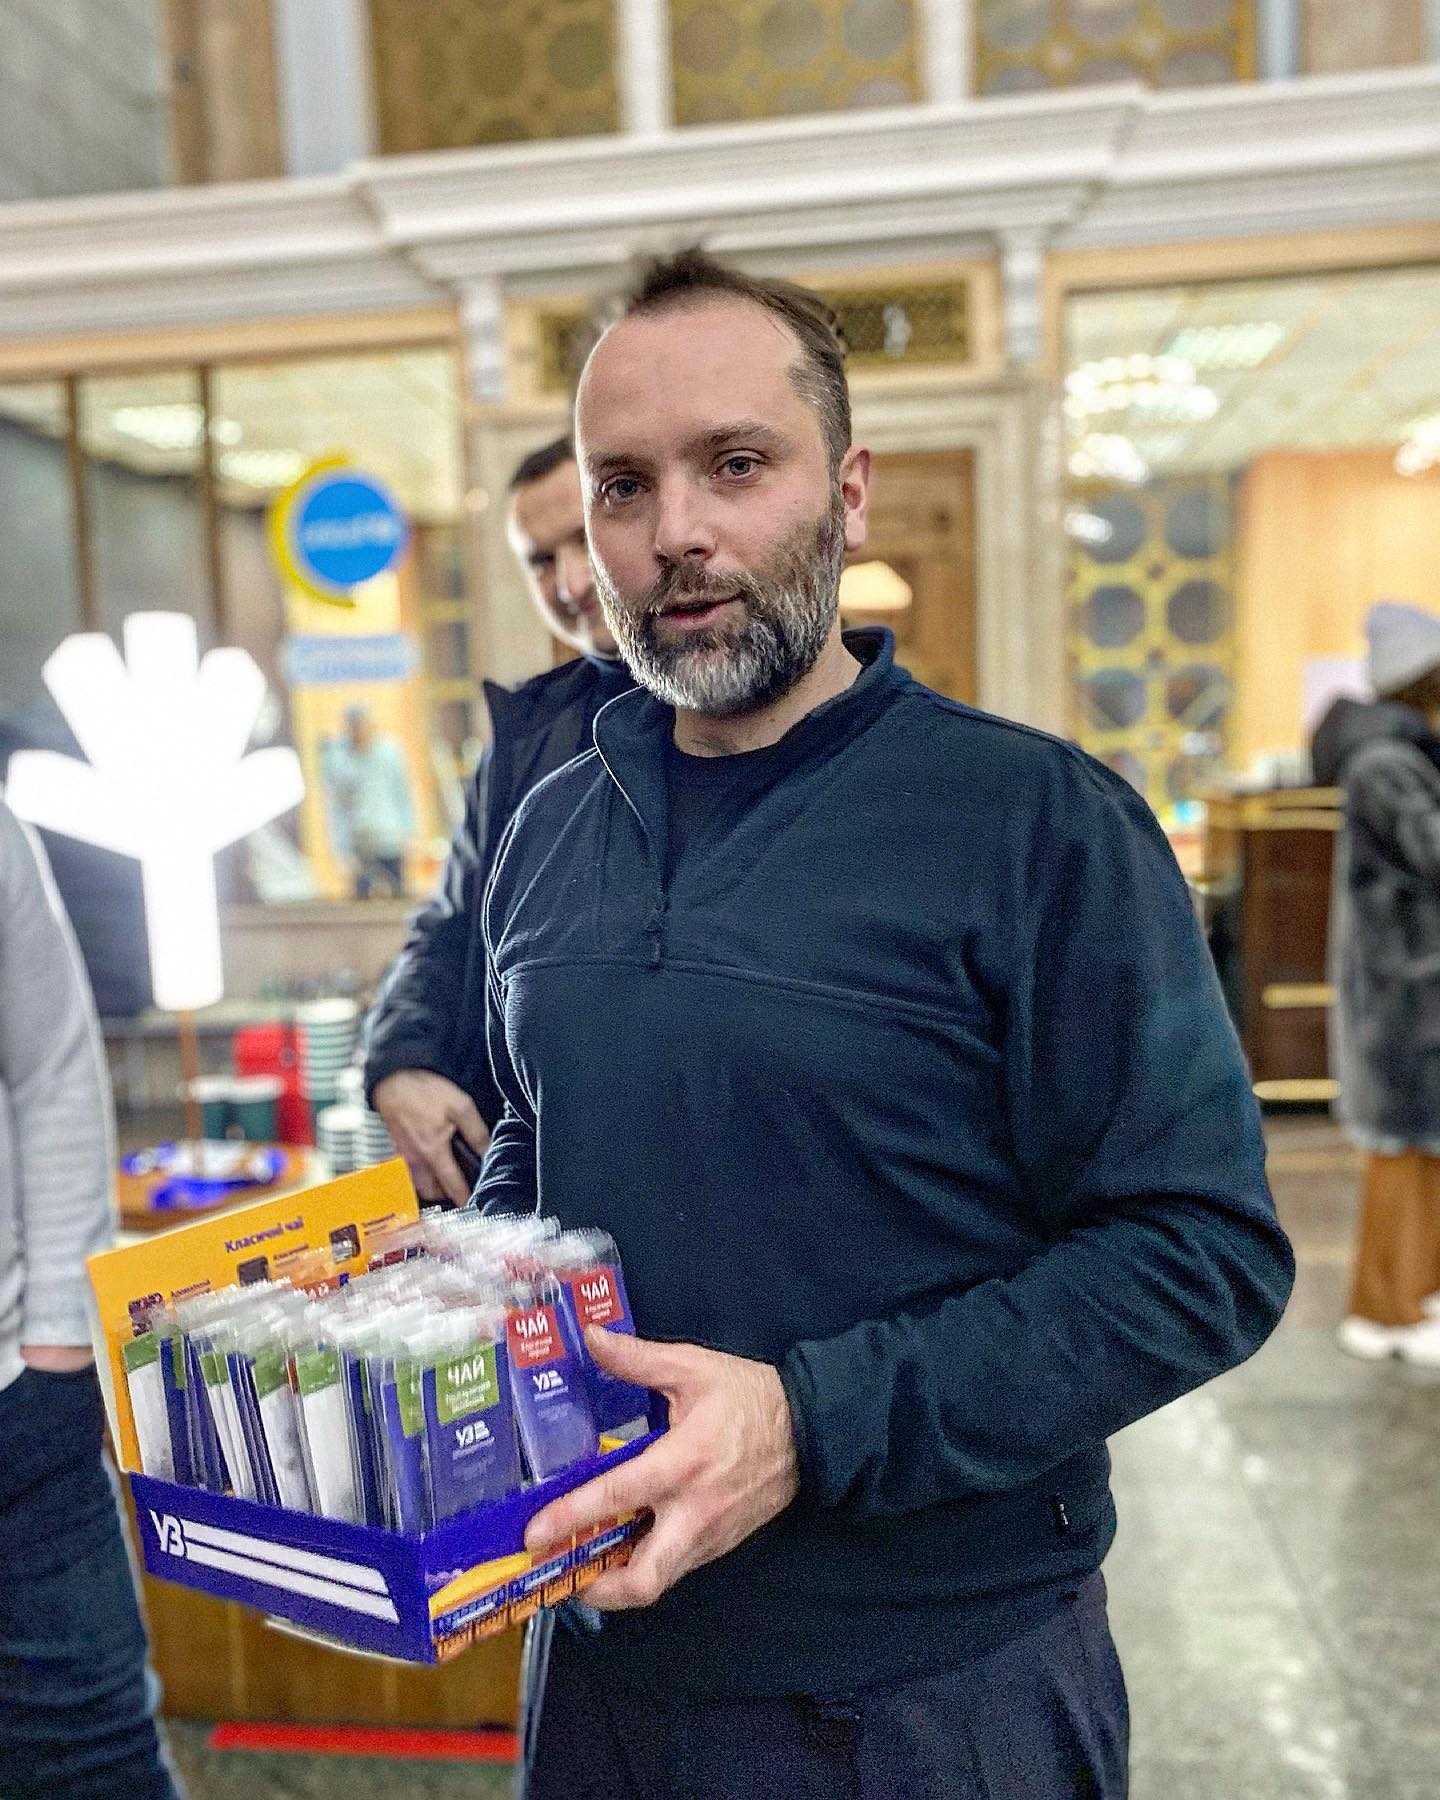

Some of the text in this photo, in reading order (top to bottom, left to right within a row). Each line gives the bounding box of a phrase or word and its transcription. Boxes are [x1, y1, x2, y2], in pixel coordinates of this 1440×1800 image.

[225, 1223, 283, 1253] Класичні
[581, 1274, 610, 1302] ЧАЙ
[515, 1309, 548, 1339] ЧАЙ
[447, 1354, 485, 1387] ЧАЙ
[148, 1508, 185, 1558] УЗ
